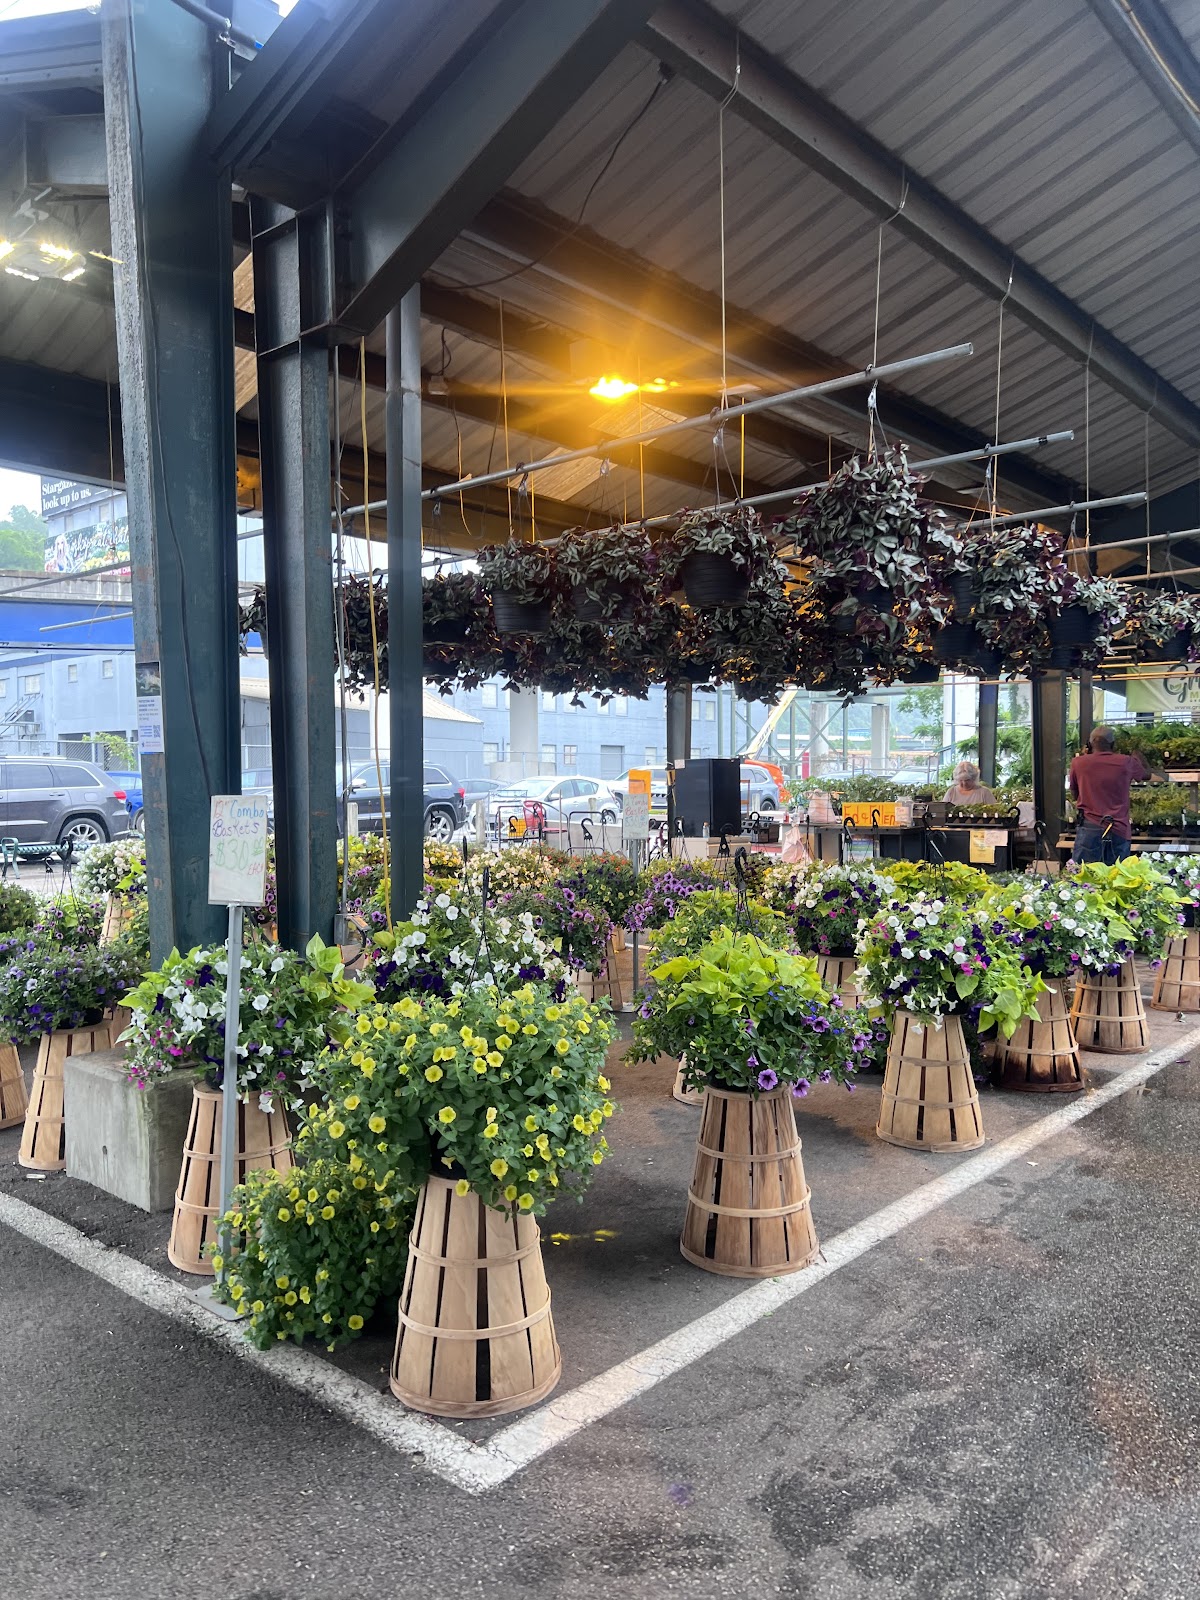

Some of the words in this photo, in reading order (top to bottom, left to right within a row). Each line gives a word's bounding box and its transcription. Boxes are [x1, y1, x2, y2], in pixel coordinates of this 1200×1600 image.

[43, 495, 59, 511] look
[60, 494, 70, 507] up
[71, 490, 79, 502] to
[230, 799, 265, 819] Combo
[212, 818, 260, 837] Baskets
